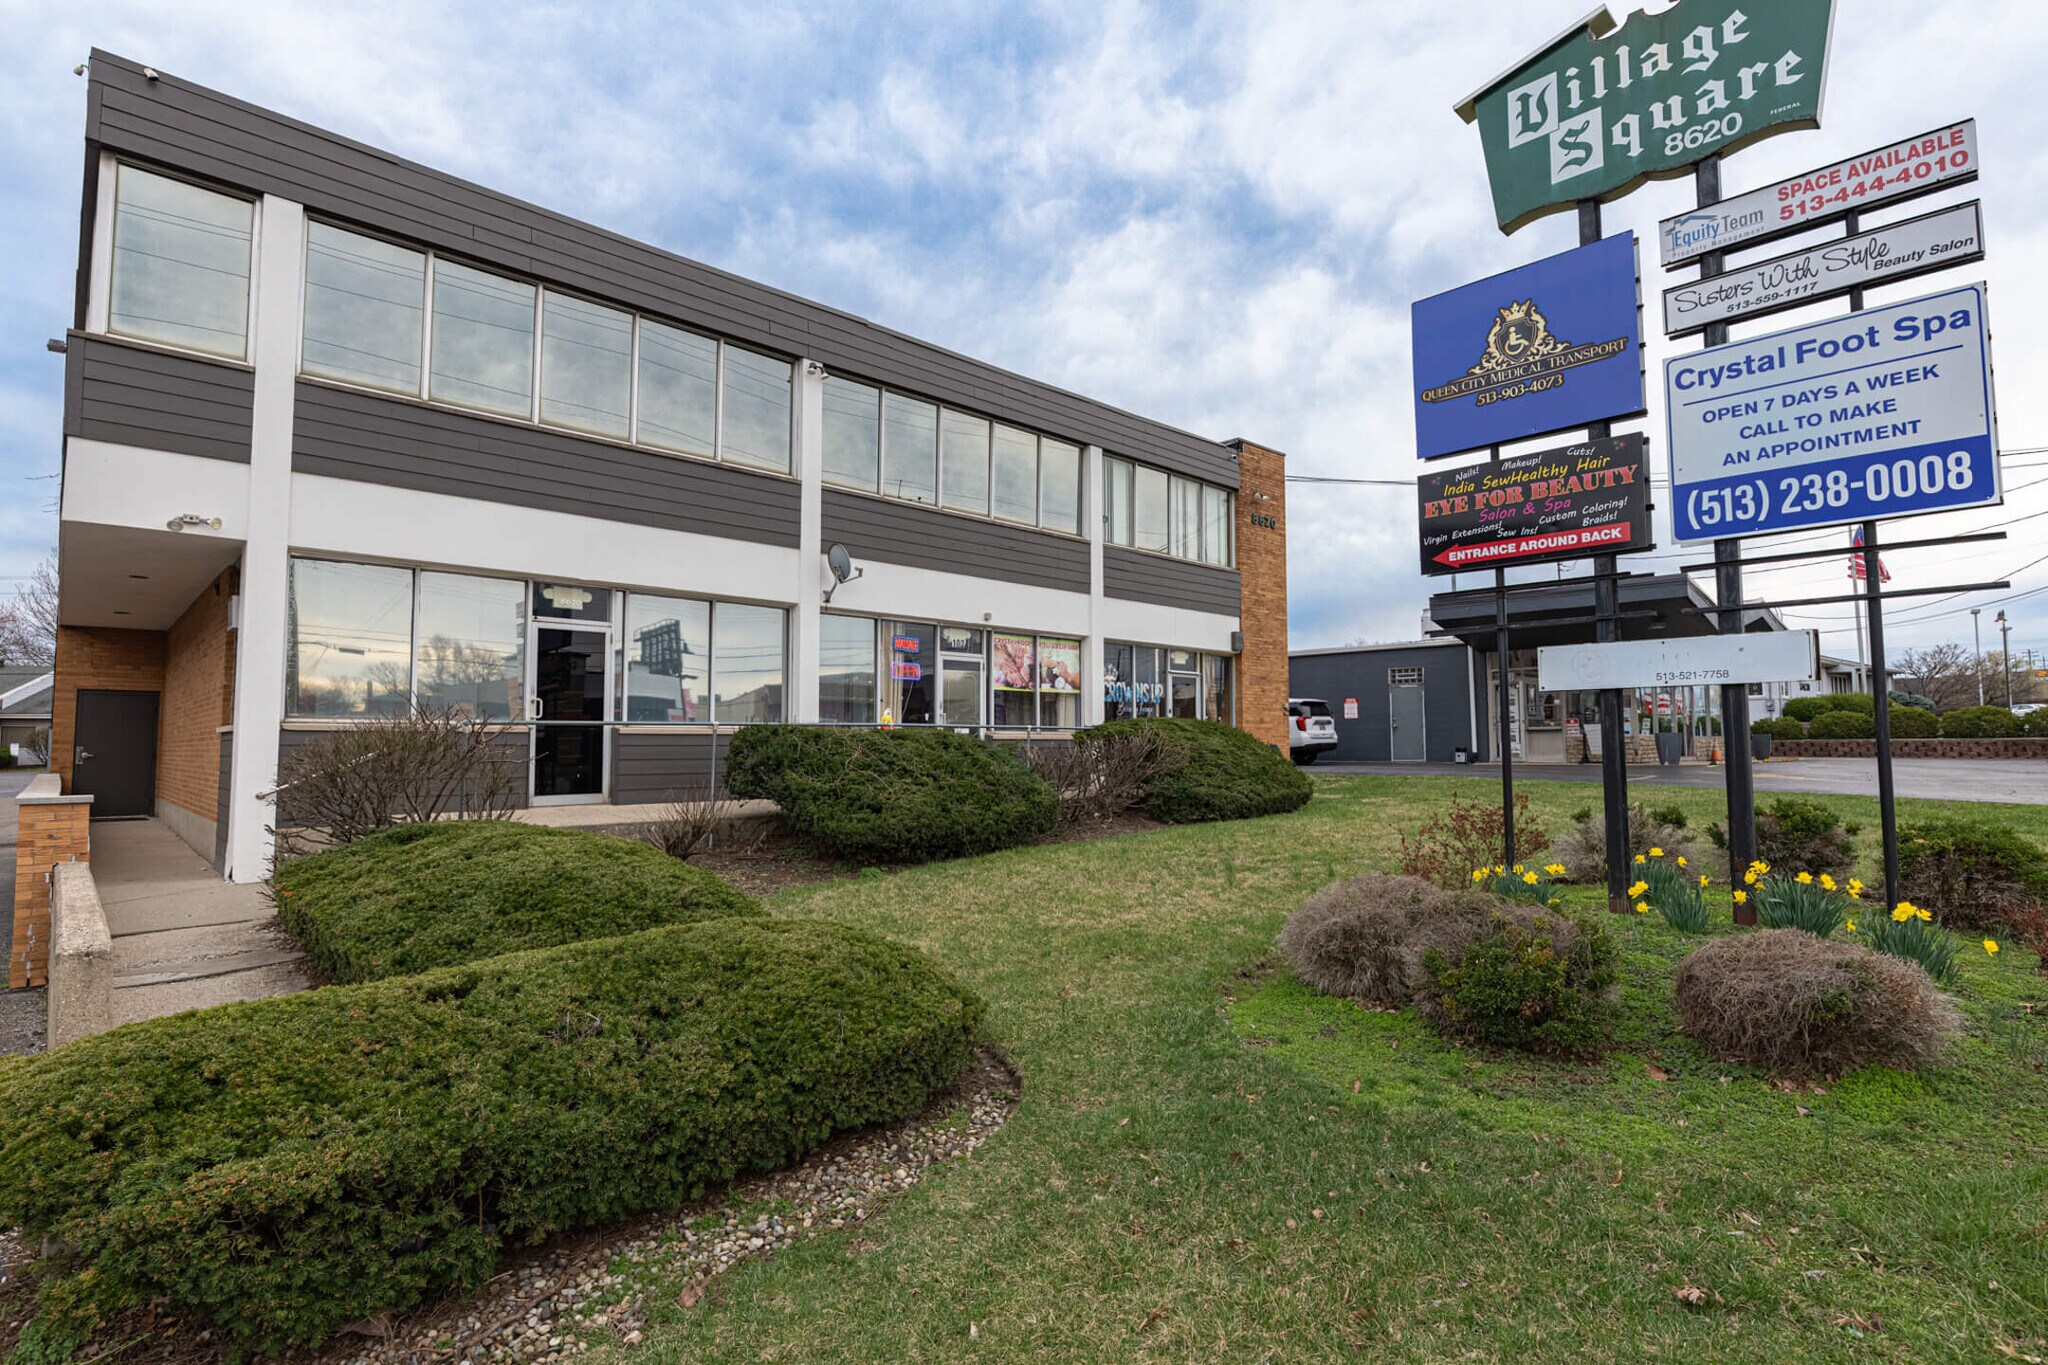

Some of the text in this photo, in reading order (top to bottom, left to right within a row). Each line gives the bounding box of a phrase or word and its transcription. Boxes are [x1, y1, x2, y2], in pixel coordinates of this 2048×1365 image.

[1510, 9, 1750, 146] Village
[1553, 49, 1805, 180] Square
[1664, 112, 1742, 156] 8620
[1778, 128, 1965, 202] SPACE AVAILABLE
[1780, 150, 1969, 221] 513-444-4010
[1673, 226, 1765, 258] Property Management
[1674, 210, 1764, 247] Equity Team
[1873, 236, 1974, 271] Beauty Salon
[1675, 237, 1890, 313] Sisters With Style
[1726, 281, 1818, 313] 513-559-1117
[1675, 309, 1971, 391] Crystal Foot Spa
[1422, 337, 1628, 402] QUEEN CITY MEDICAL TRANSPORT
[1477, 375, 1563, 405] 513-903-4073
[1702, 364, 1941, 424] OPEN 7 DAYS A WEEK
[1739, 398, 1897, 440] CALL TO MAKE
[1566, 447, 1595, 456] Cuts!
[1722, 419, 1921, 466] AN APPOINTMENT
[1443, 483, 1475, 497] India
[1576, 456, 1611, 472] Hair
[1455, 466, 1480, 482] Nails!
[1501, 455, 1542, 471] Makeup!
[1424, 464, 1639, 519] EYE FOR BEAUTY
[1687, 451, 1973, 530] (513) 238-0008
[1251, 512, 1276, 529] 8620
[1478, 497, 1571, 523] Salon & Spa
[1539, 496, 1629, 525] Custom Coloring!
[1582, 511, 1618, 527] Braids!
[1423, 521, 1503, 546] Virgin Extensions!
[1448, 527, 1622, 562] ENTRANCE AROUND BACK
[1497, 526, 1539, 538] Sew Ins!
[893, 664, 919, 679] OPEN
[1656, 669, 1730, 682] 513-521-7758
